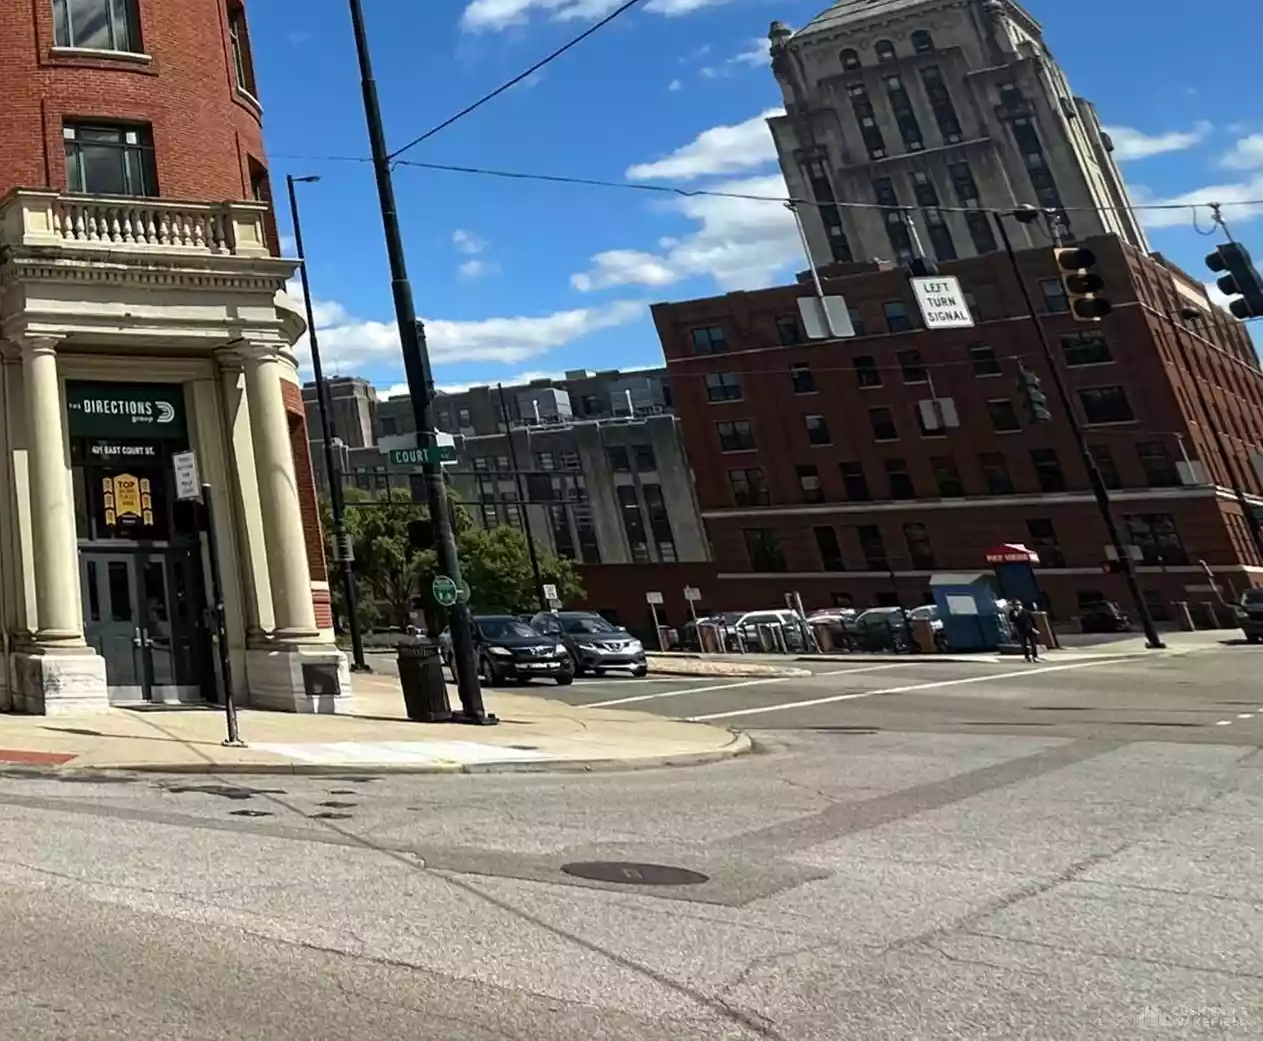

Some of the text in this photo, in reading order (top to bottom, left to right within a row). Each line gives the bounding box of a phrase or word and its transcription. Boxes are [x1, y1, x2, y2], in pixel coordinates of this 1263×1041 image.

[923, 282, 949, 293] LEFT
[926, 297, 956, 307] TURN
[927, 311, 968, 322] SIGNAL
[83, 399, 152, 415] DIRECTIONS
[104, 446, 121, 455] EAST
[122, 446, 144, 455] COURT
[396, 449, 429, 463] COURT
[117, 481, 135, 489] TOP
